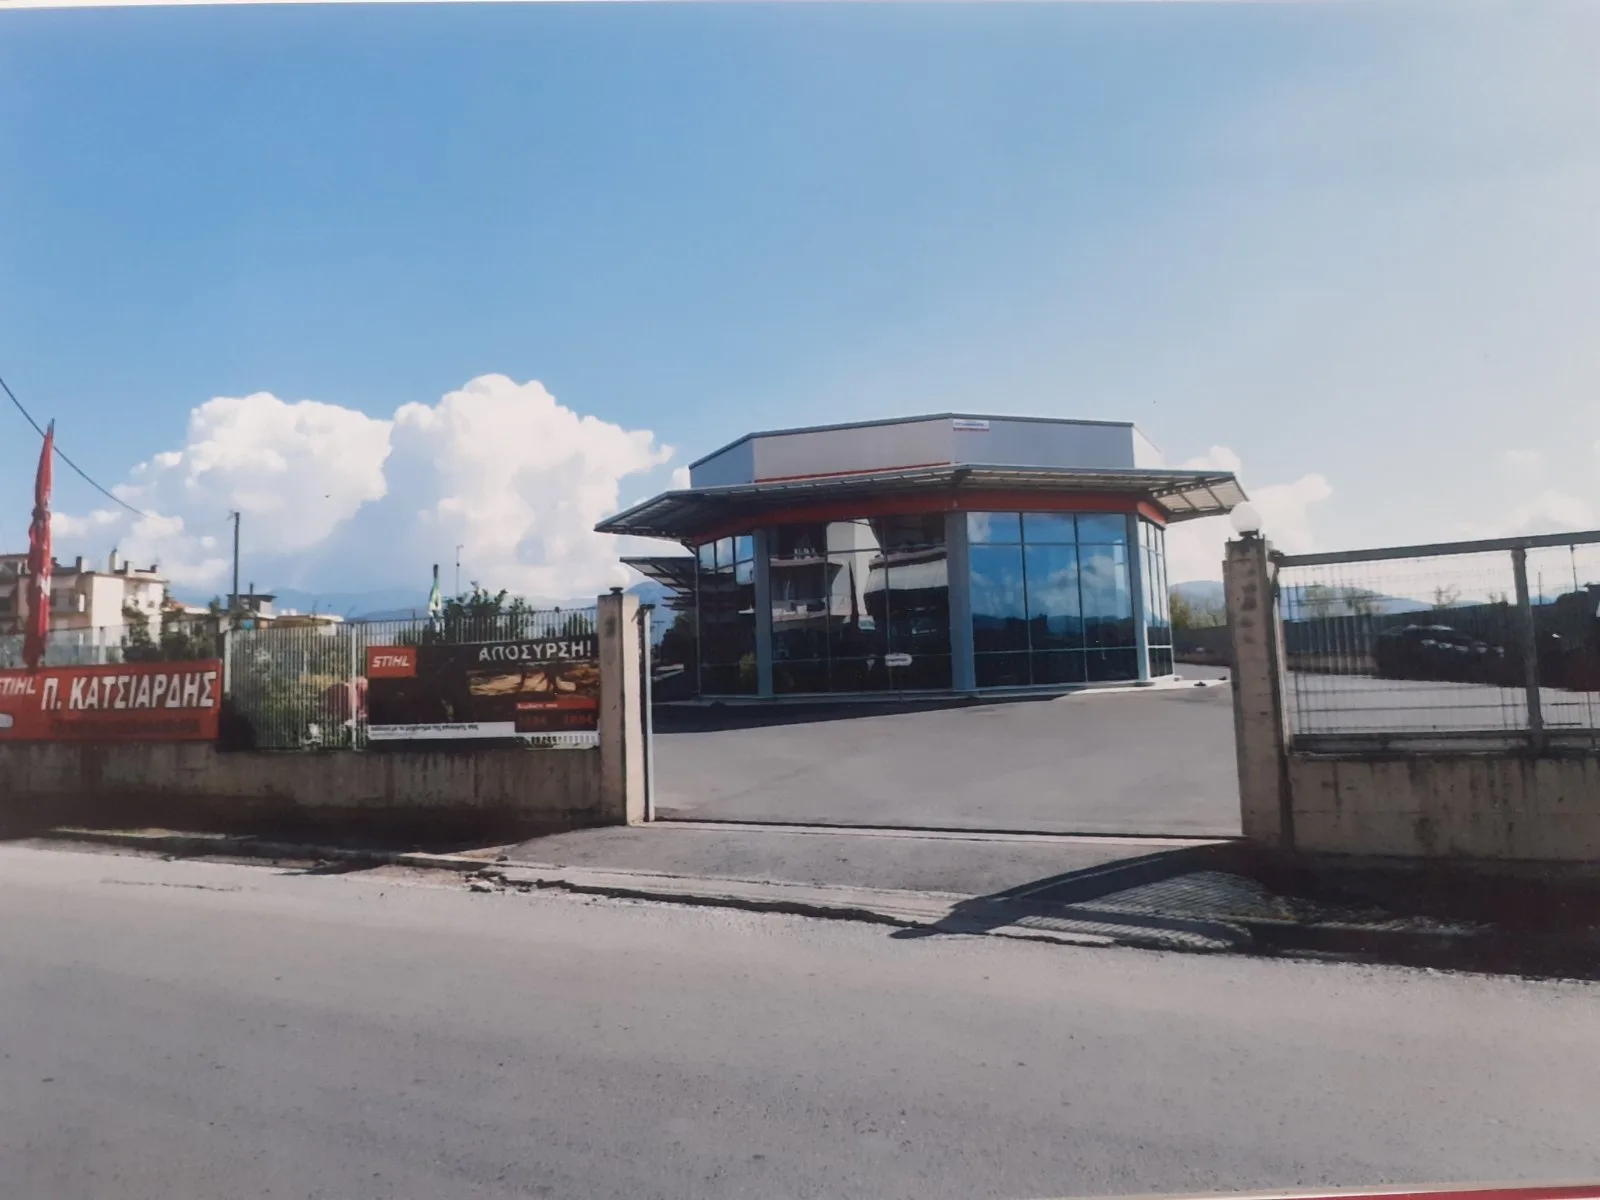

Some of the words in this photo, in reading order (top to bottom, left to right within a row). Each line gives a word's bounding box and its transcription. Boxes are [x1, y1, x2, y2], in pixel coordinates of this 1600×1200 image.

[372, 655, 411, 668] STIHL
[479, 640, 592, 662] ΑΠΟΣΥΡΣΗ!
[41, 677, 62, 710] Π.
[69, 671, 216, 710] ΚΑΤΣΙΑΡΔΗΣ
